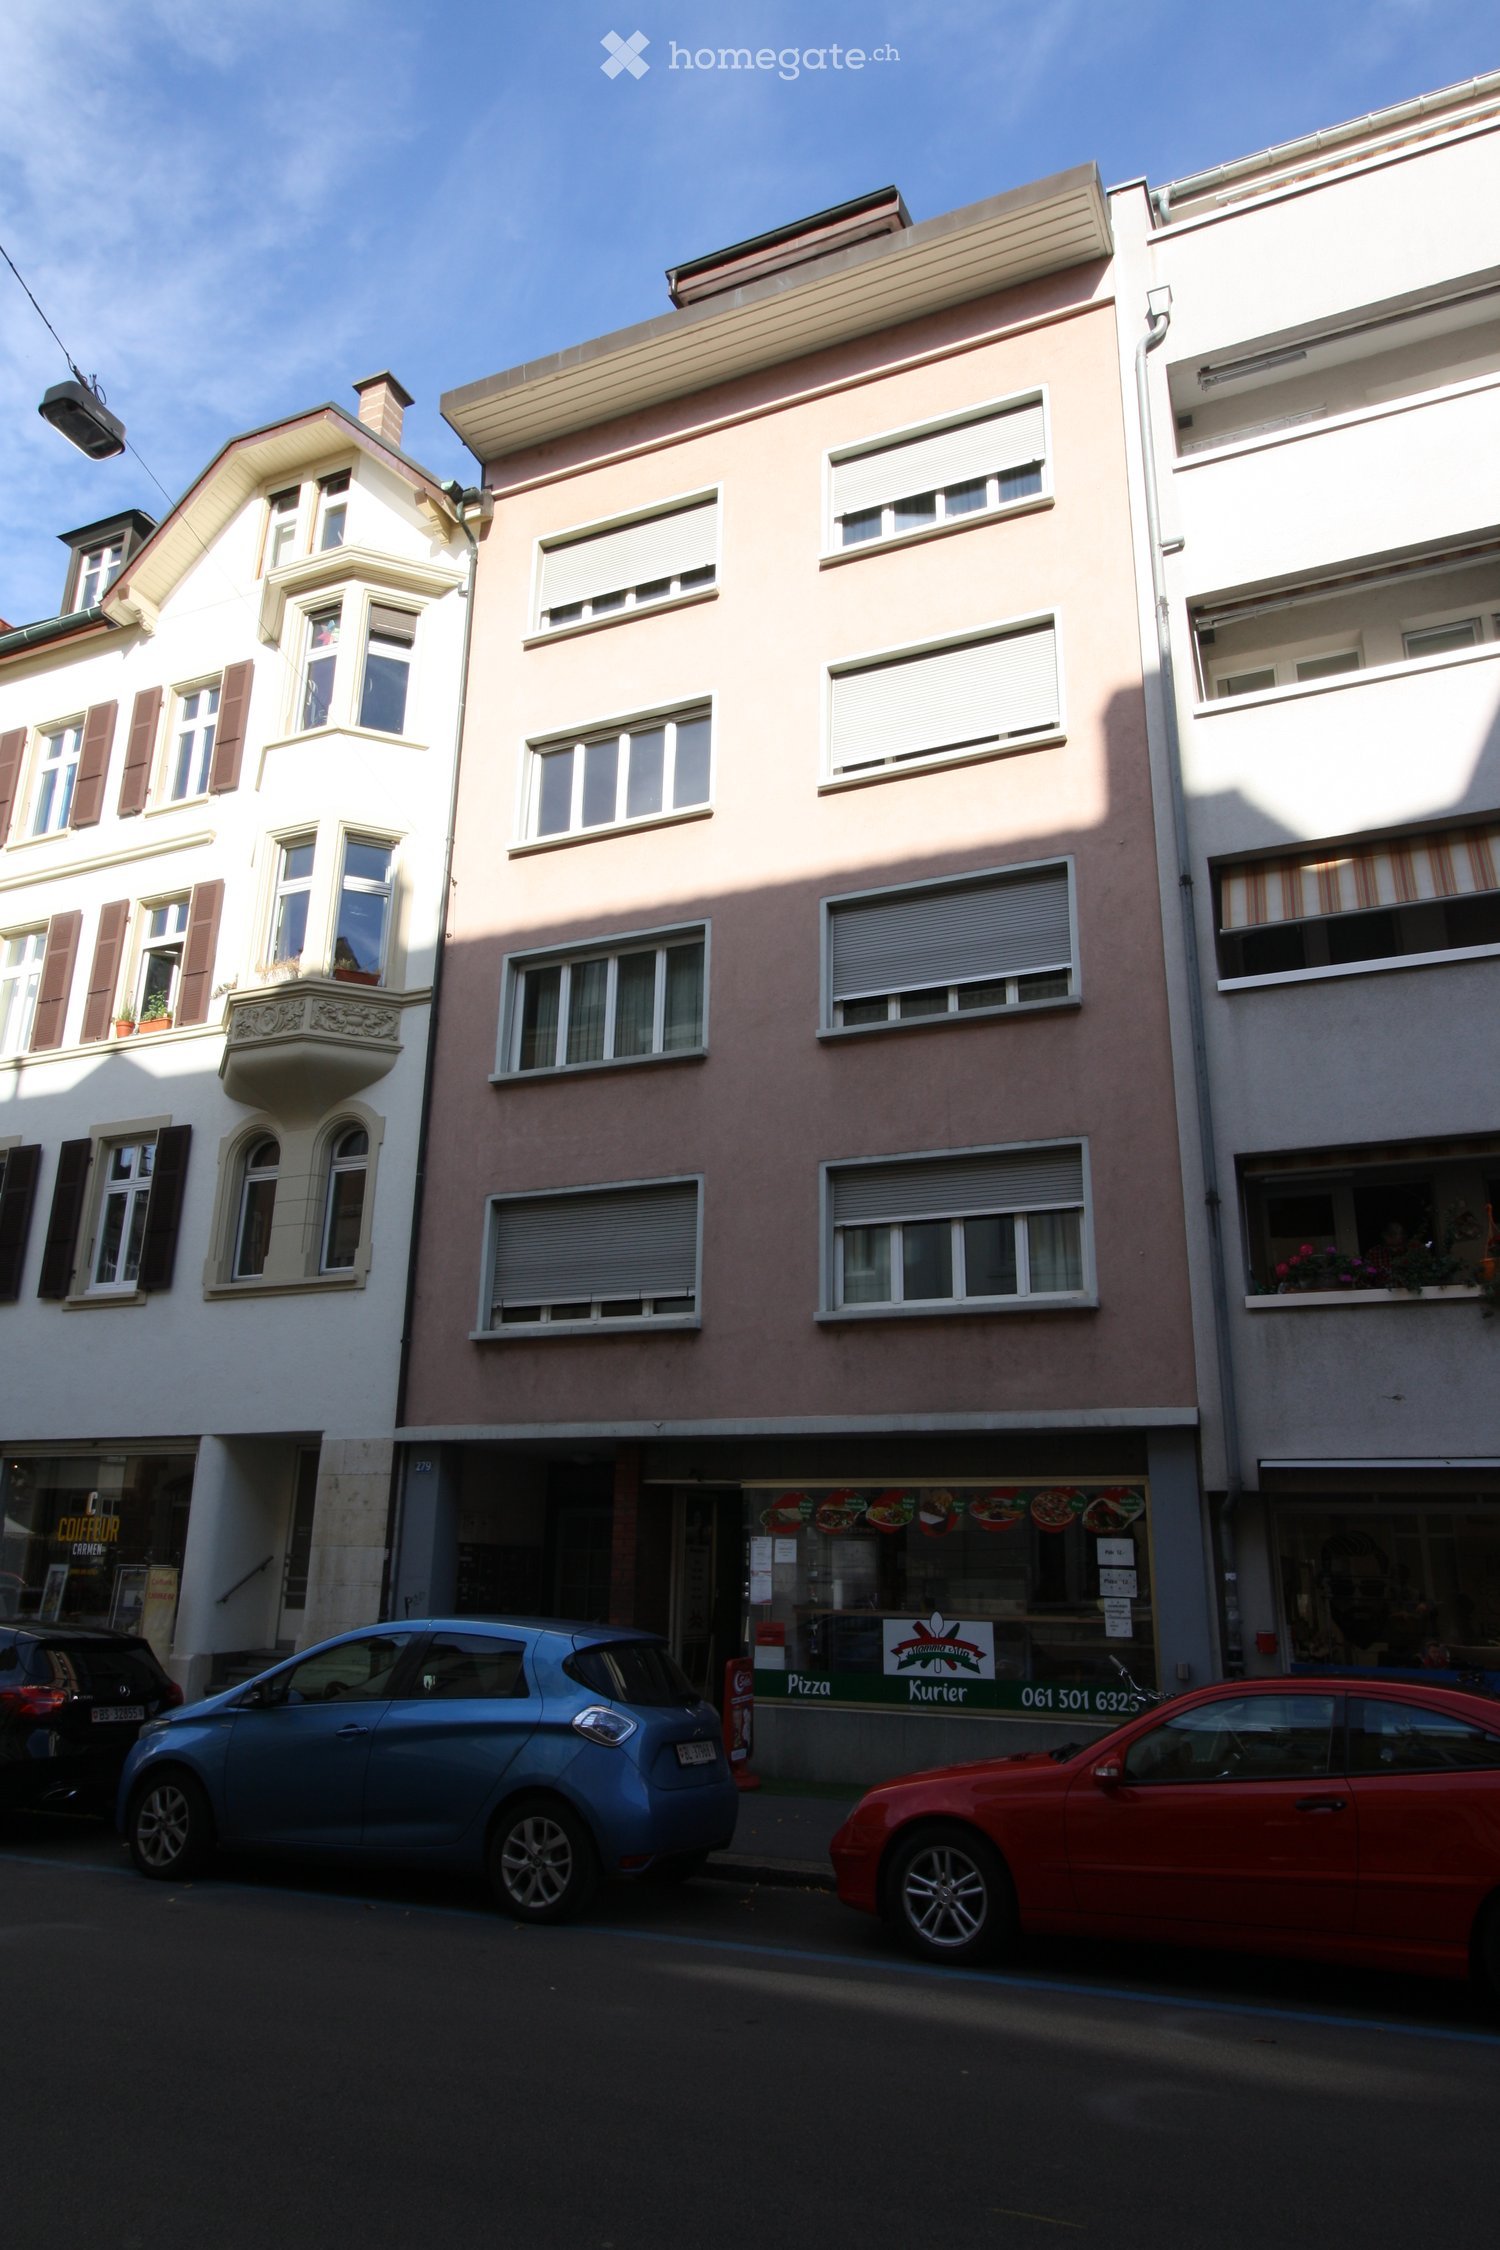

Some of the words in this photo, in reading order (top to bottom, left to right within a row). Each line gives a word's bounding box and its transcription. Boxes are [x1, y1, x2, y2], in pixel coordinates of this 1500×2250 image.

[416, 1461, 433, 1472] 279
[57, 1517, 121, 1543] COIFFEUR
[72, 1543, 103, 1556] CARMEN
[787, 1674, 831, 1696] Pizza
[909, 1679, 968, 1703] Kurier
[1021, 1687, 1053, 1708] 061
[1058, 1689, 1089, 1710] 501
